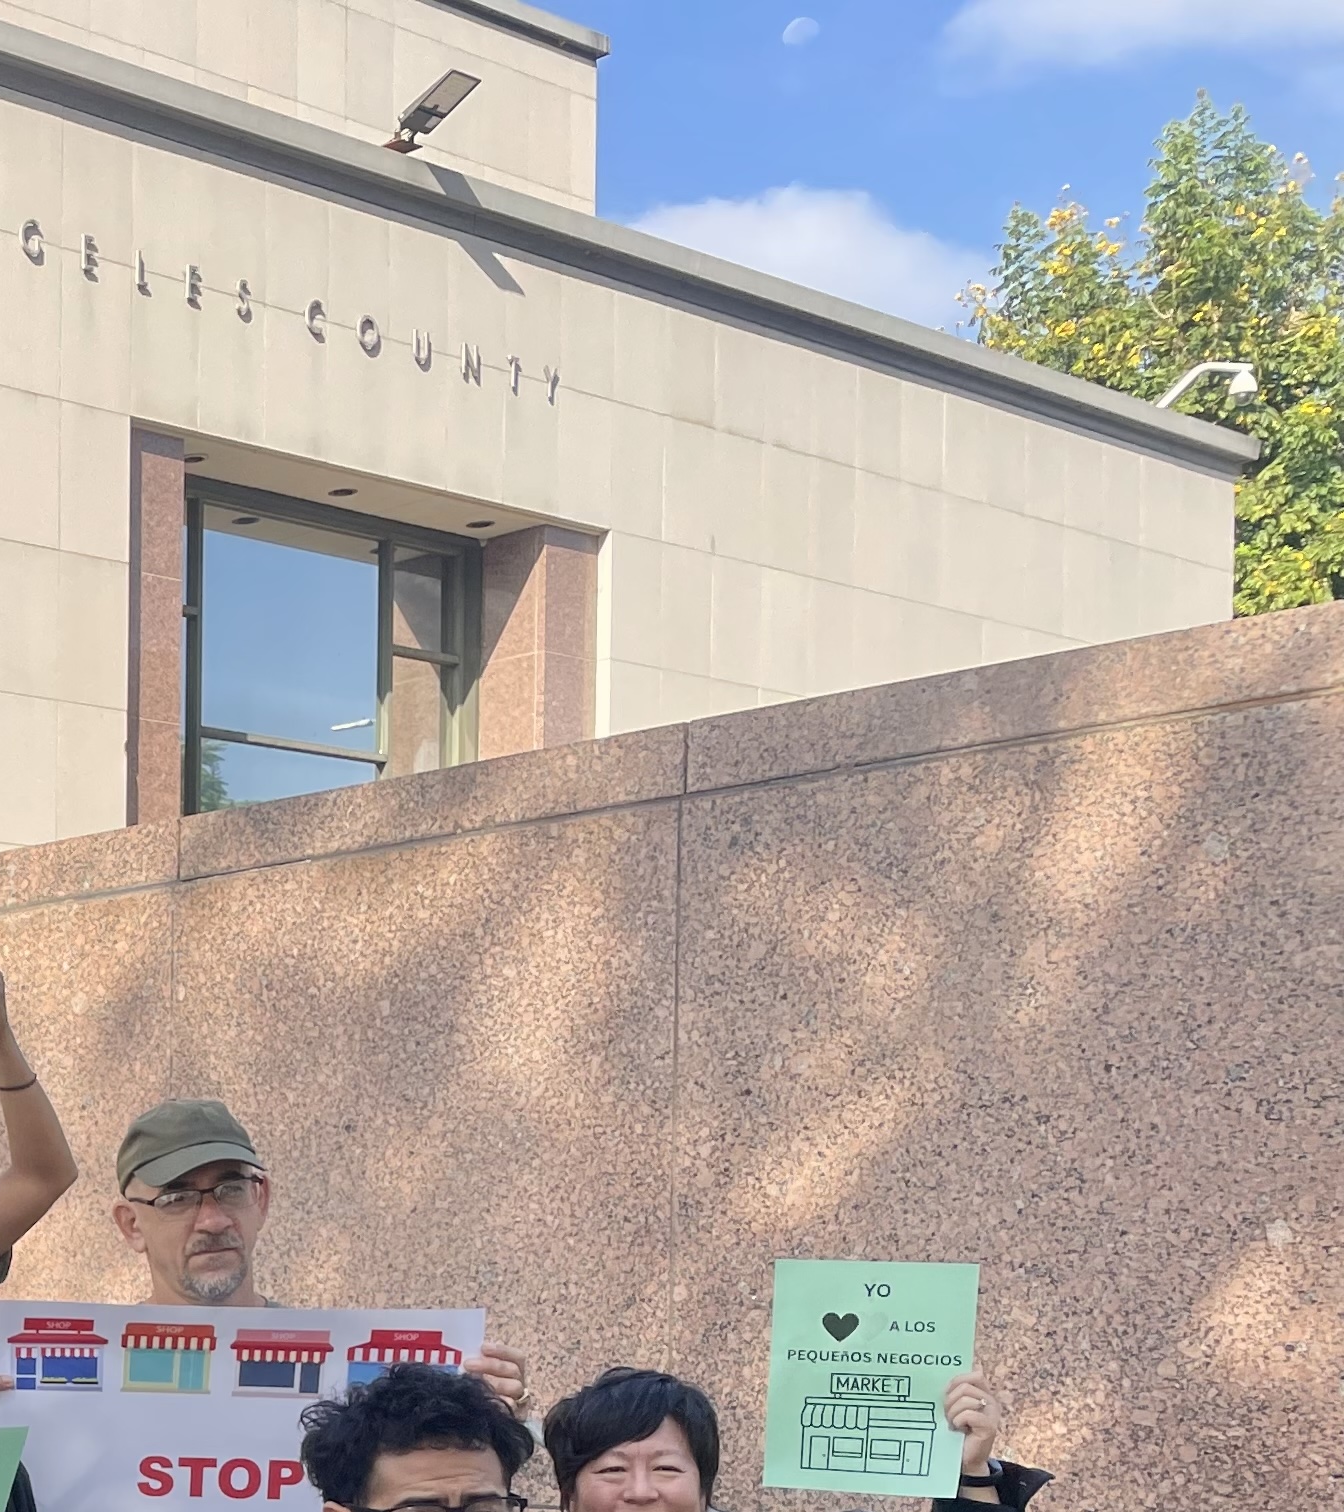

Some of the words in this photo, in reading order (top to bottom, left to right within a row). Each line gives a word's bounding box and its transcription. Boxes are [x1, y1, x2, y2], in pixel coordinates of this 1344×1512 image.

[304, 299, 560, 402] COUNTY
[865, 1284, 891, 1298] YO
[46, 1320, 72, 1330] SHOP
[156, 1325, 184, 1334] SHOP
[271, 1332, 297, 1341] SHOP
[394, 1332, 419, 1341] SHOP
[889, 1321, 900, 1332] A
[905, 1321, 936, 1333] LOS
[788, 1349, 872, 1363] PEQUEñOS
[877, 1353, 962, 1366] NEGOCIOS
[836, 1376, 905, 1394] MARKET
[138, 1456, 304, 1500] STOP
